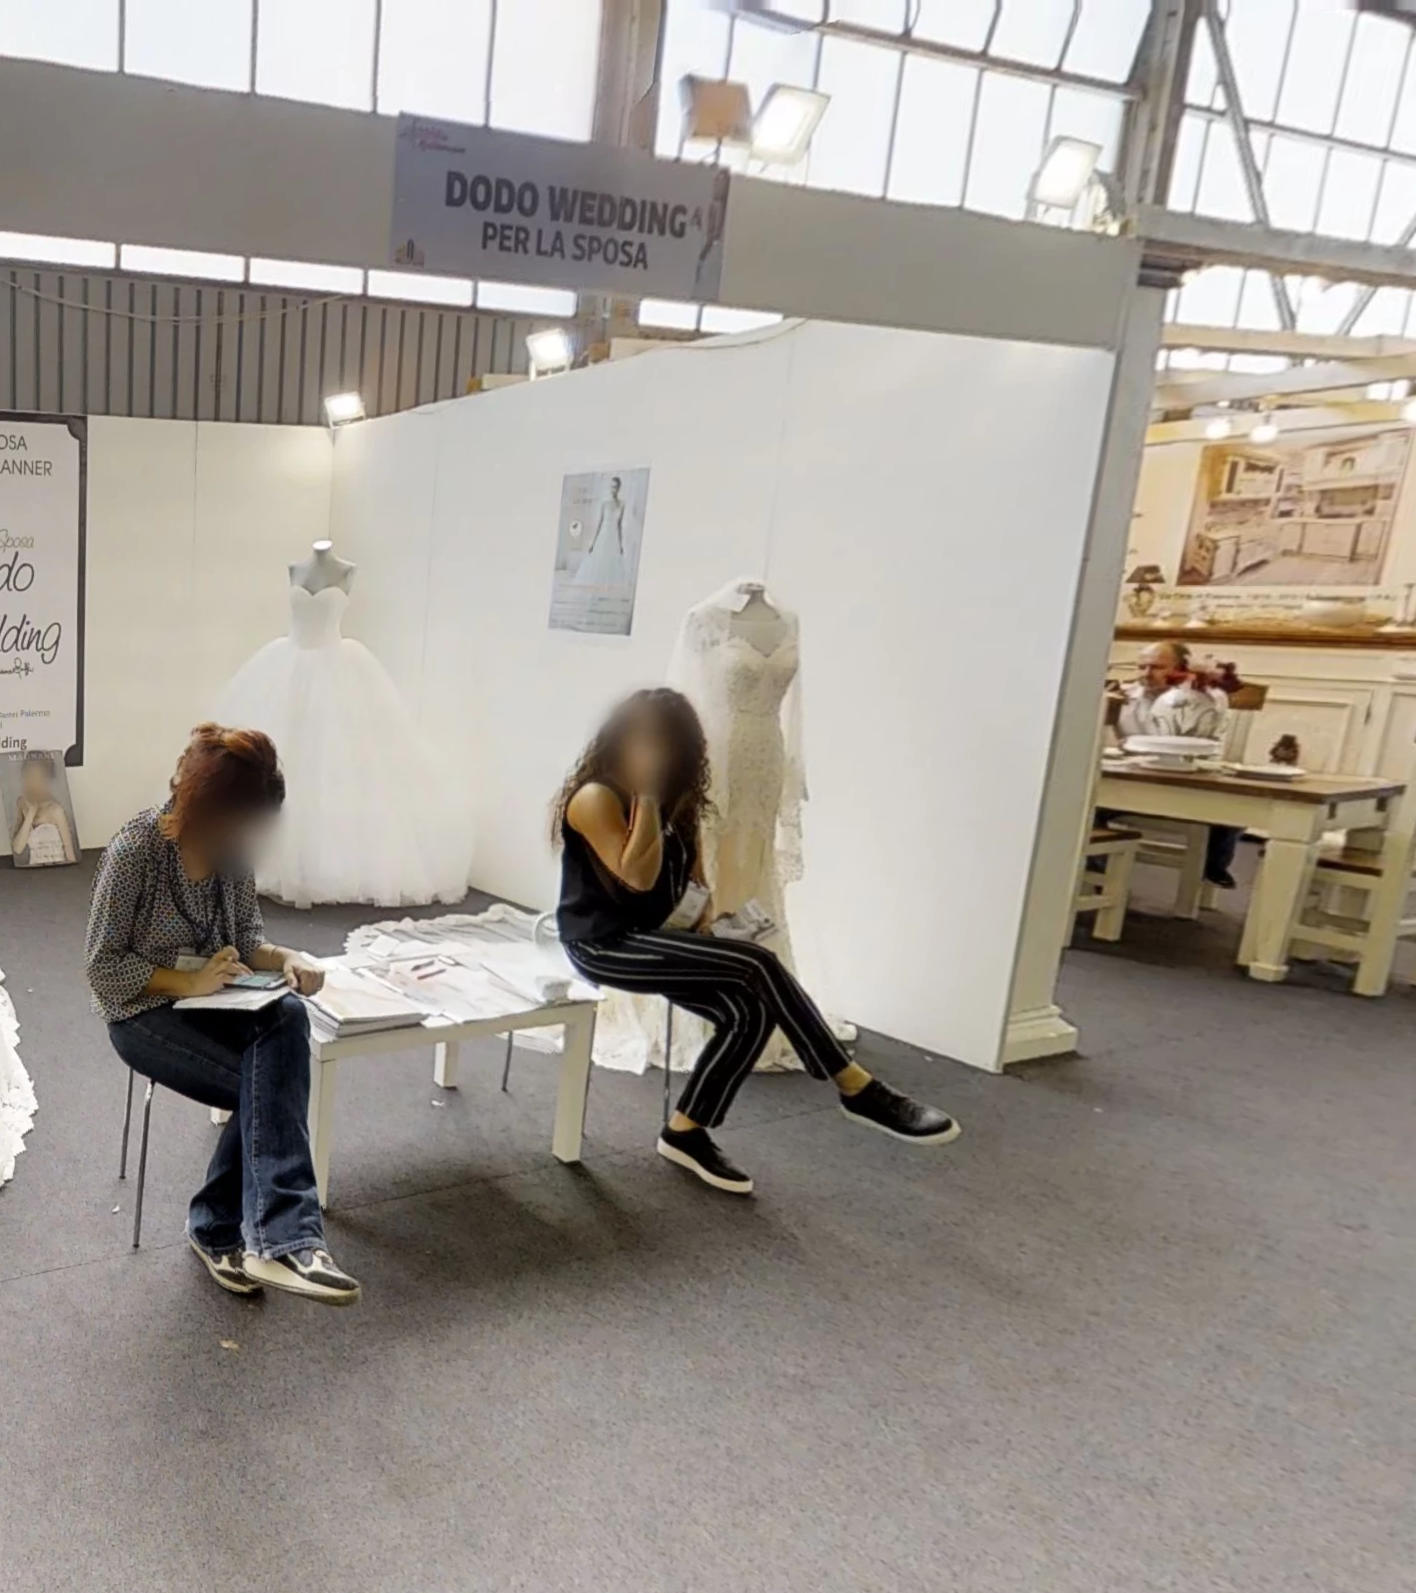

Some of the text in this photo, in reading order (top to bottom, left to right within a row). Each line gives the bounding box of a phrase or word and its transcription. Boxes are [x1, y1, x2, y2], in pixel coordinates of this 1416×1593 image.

[445, 170, 688, 239] DODO WEDDING
[481, 221, 649, 271] PER LA SPOSA
